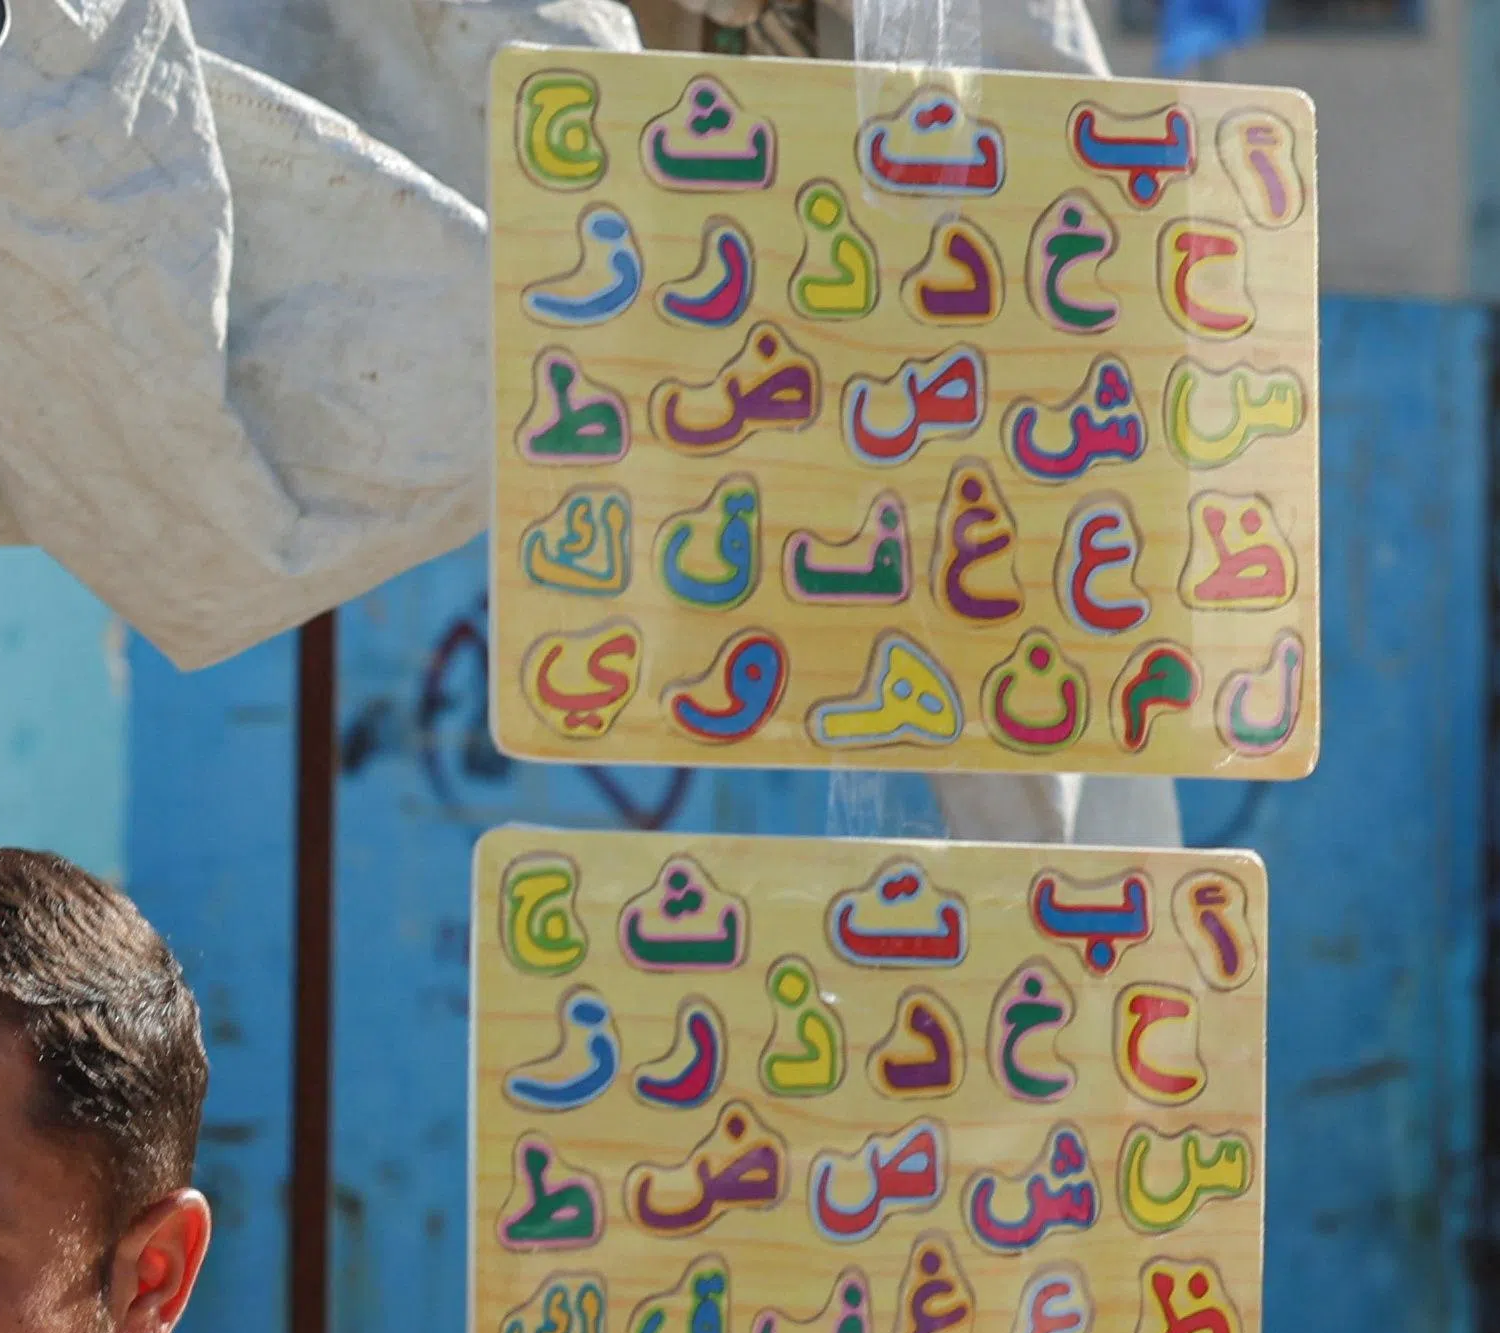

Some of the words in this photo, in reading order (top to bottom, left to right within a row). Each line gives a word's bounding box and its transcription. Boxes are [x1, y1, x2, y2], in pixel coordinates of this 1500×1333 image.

[505, 862, 588, 974] ج
[622, 868, 744, 969] ث
[831, 870, 964, 966] ت
[1033, 872, 1148, 971] ب
[1193, 883, 1244, 979] أ
[505, 999, 615, 1104] ز
[636, 1007, 716, 1104] ر
[766, 968, 836, 1094] ذ
[878, 999, 961, 1096] د
[1000, 974, 1073, 1099] خ
[1123, 991, 1201, 1099] ح
[502, 1147, 595, 1247] ط
[634, 1112, 783, 1232] ض
[814, 1128, 941, 1237] ص
[972, 1130, 1095, 1250] ش
[1123, 1130, 1248, 1232] س
